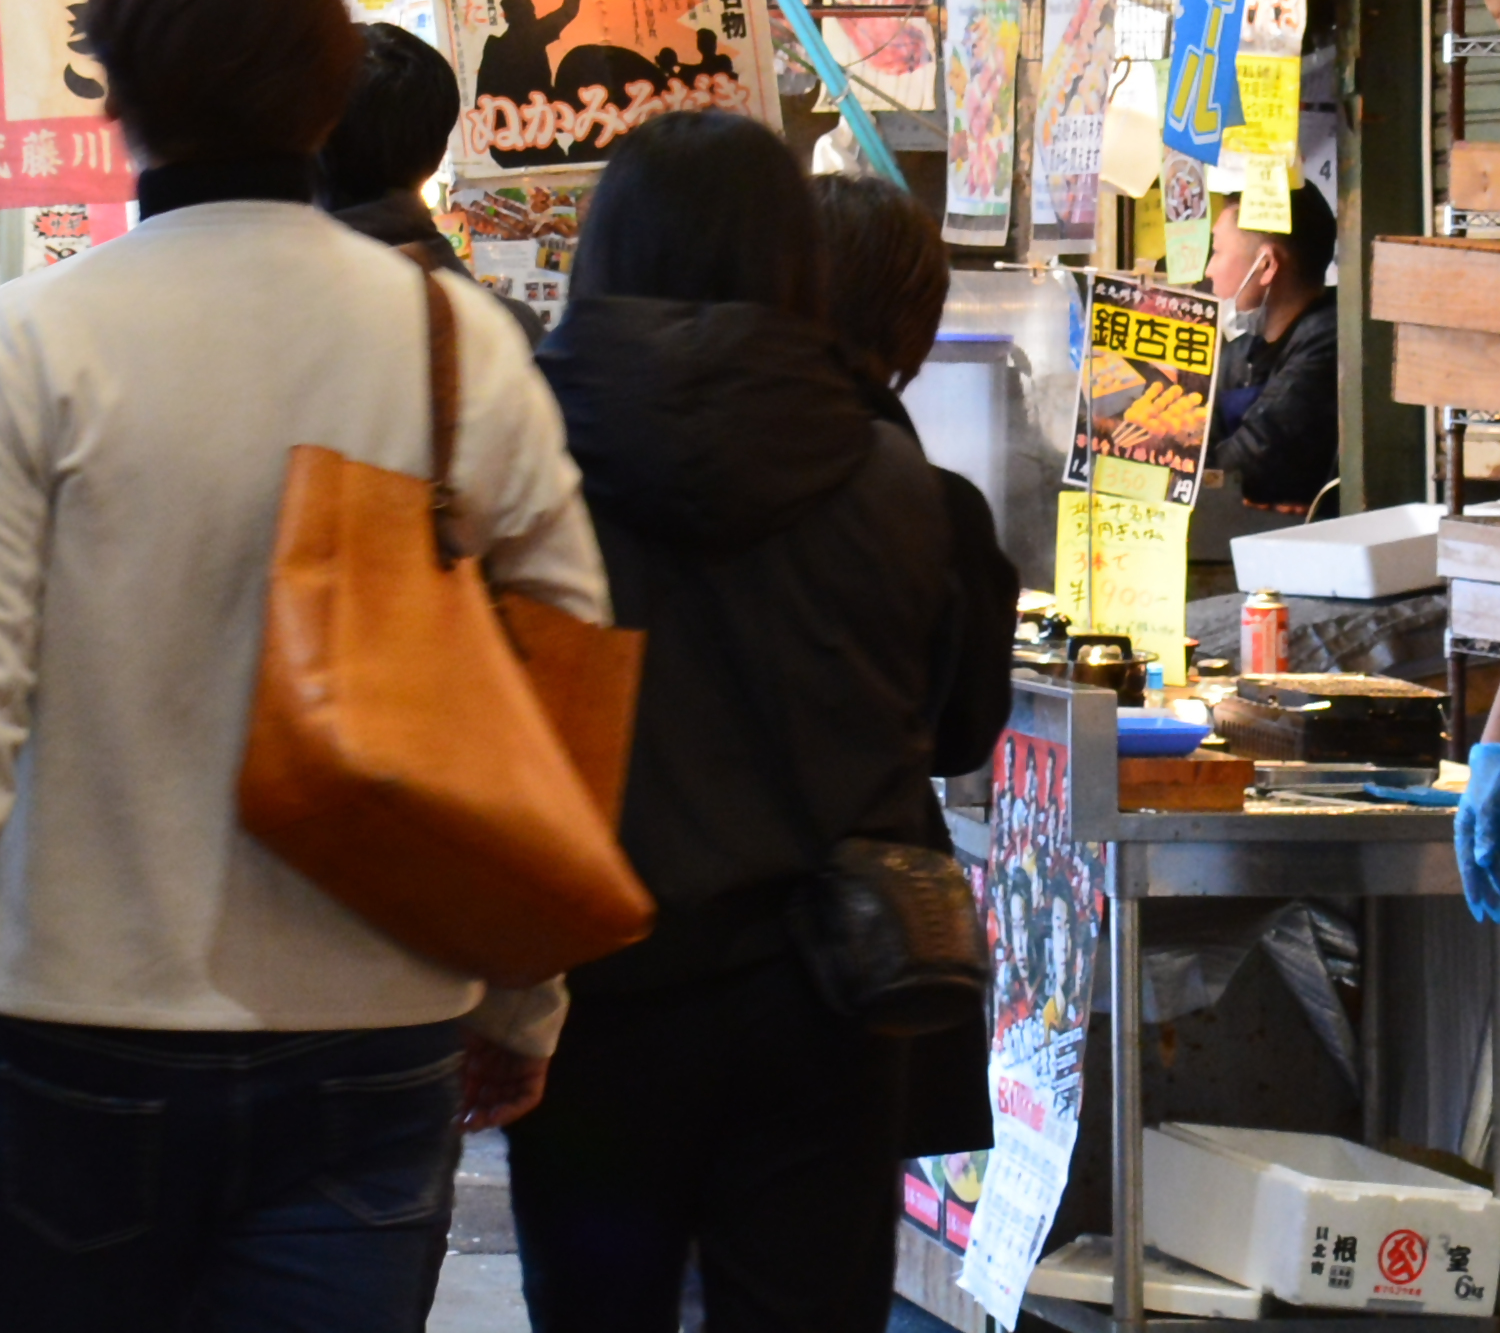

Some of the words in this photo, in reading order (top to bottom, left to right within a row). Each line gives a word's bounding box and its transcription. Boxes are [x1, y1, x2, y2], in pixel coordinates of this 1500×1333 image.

[1091, 308, 1210, 367] 銀杏串
[1105, 466, 1147, 491] 350
[1172, 479, 1194, 504] 円
[1331, 1234, 1358, 1263] 根
[1446, 1244, 1472, 1273] 室
